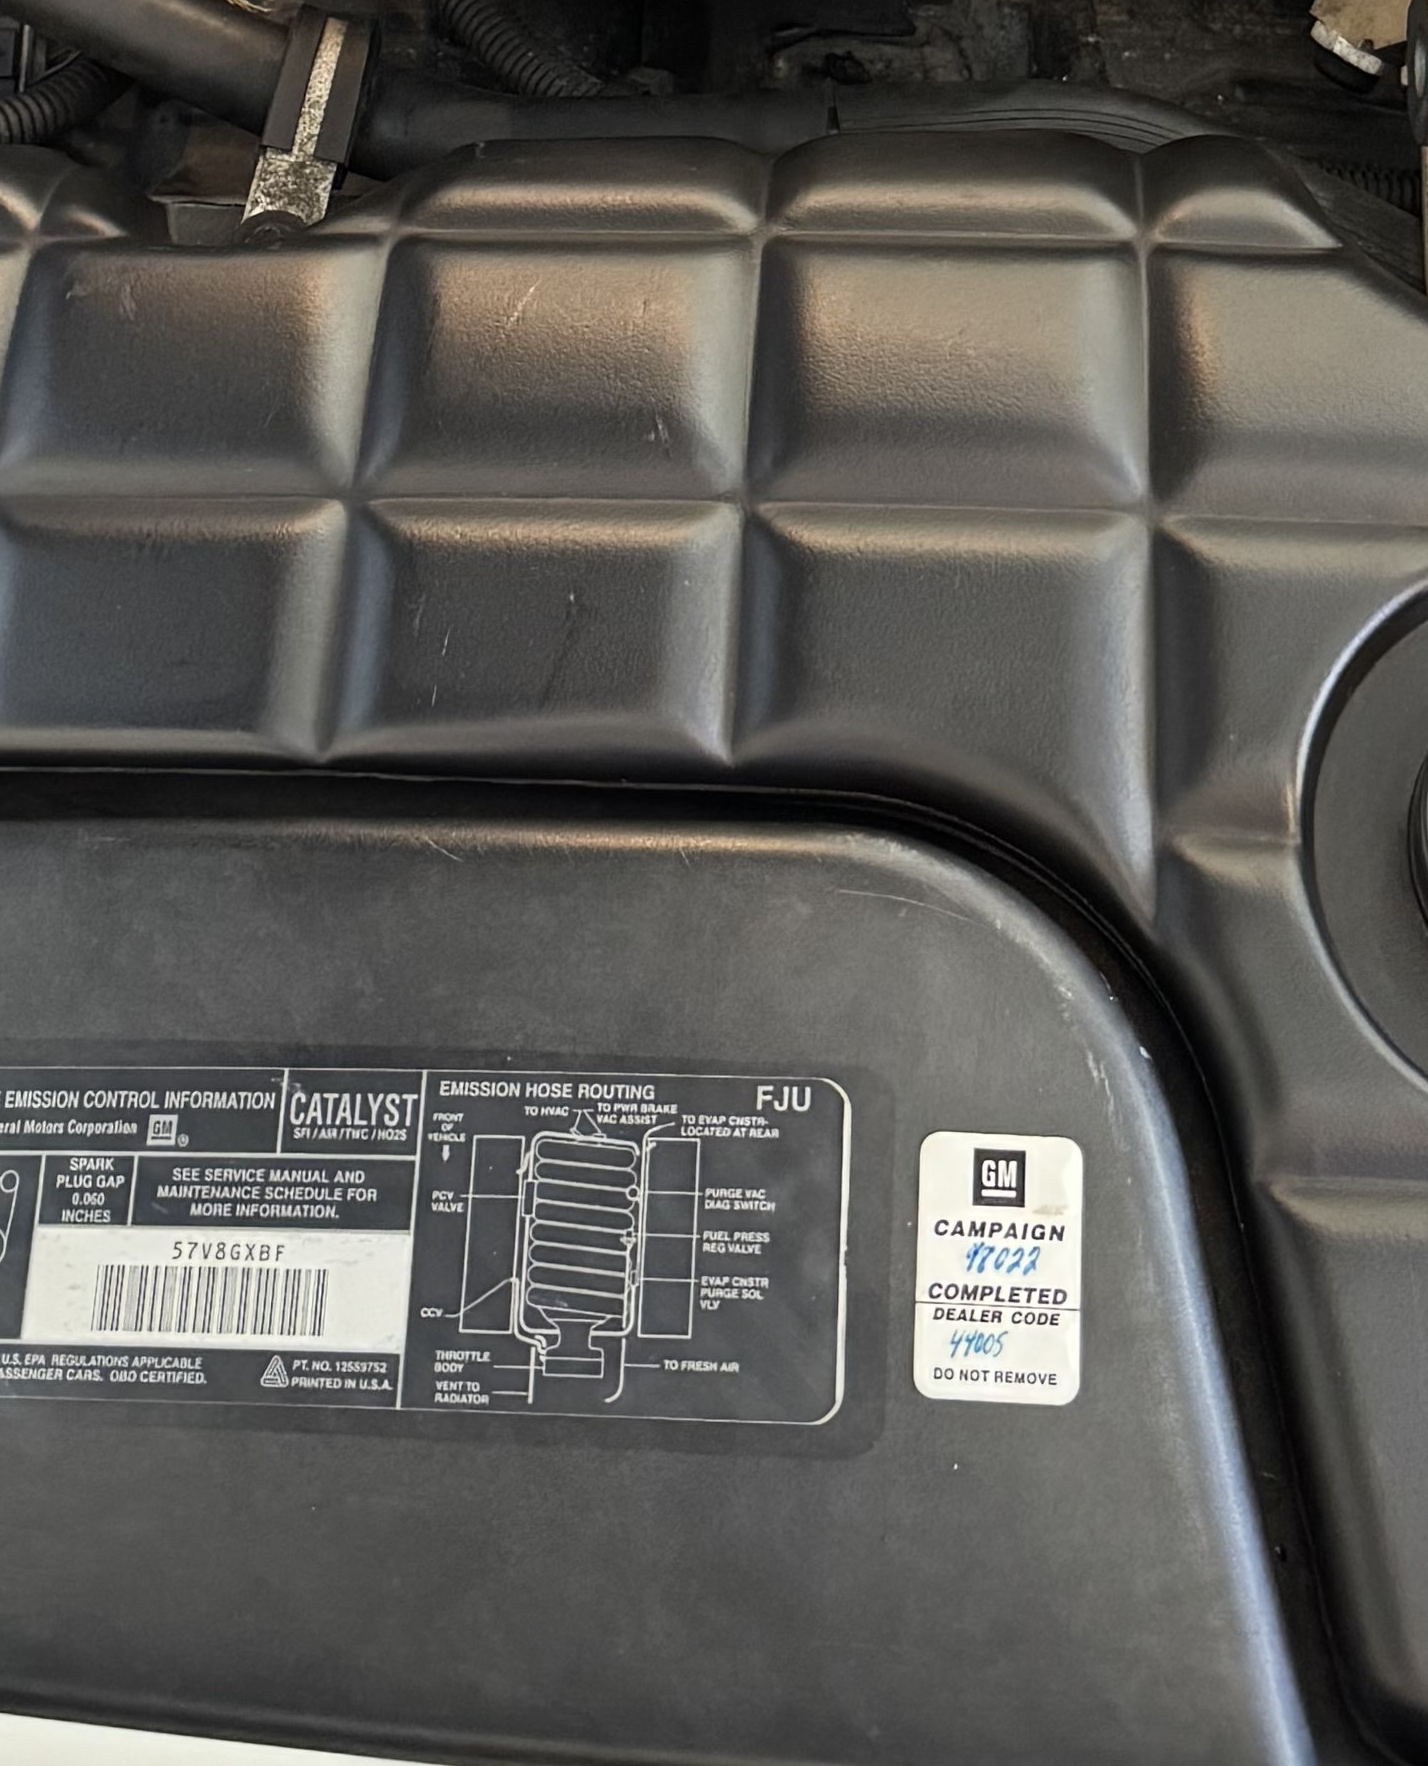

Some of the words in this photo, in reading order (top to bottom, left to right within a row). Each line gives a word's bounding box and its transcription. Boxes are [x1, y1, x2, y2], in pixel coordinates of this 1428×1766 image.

[440, 1081, 520, 1097] EMISSION
[526, 1082, 573, 1098] HOSE
[578, 1084, 655, 1100] ROUTING
[5, 1090, 80, 1108] EMISSION
[83, 1091, 160, 1109] CONTROL
[164, 1091, 275, 1110] INFORMATION
[756, 1085, 811, 1112] FJU
[289, 1092, 418, 1127] CATALYST
[524, 1106, 538, 1116] TO
[541, 1106, 569, 1117] HVAC
[598, 1103, 611, 1113] TO
[614, 1103, 638, 1113] PWR
[640, 1103, 678, 1114] BRAKE
[433, 1113, 464, 1122] FRONT
[597, 1114, 618, 1124] VAC
[619, 1115, 658, 1125] ASSIST
[682, 1115, 696, 1125] TO
[699, 1115, 726, 1125] EVAP
[24, 1120, 64, 1134] Motors
[68, 1120, 137, 1137] Corporation
[441, 1123, 453, 1132] OF
[681, 1126, 731, 1137] LOCATED
[733, 1127, 747, 1137] AT
[749, 1128, 780, 1138] REAR
[428, 1133, 466, 1142] VEHICLE
[70, 1158, 114, 1170] SPARK
[172, 1168, 199, 1181] SEE
[205, 1168, 265, 1182] SERVICE
[269, 1169, 329, 1183] MANUAL
[334, 1170, 365, 1183] AND
[981, 1159, 1018, 1189] GM
[56, 1175, 92, 1188] PLUG
[96, 1175, 125, 1188] GAP
[72, 1192, 105, 1205] 0.060
[157, 1185, 260, 1199] MAINTENANCE
[265, 1187, 342, 1201] SCHEDULE
[347, 1188, 377, 1202] FOR
[432, 1190, 454, 1200] PCV
[705, 1188, 743, 1199] PURGE
[745, 1189, 766, 1199] VAC
[190, 1203, 231, 1217] MORE
[236, 1203, 340, 1218] INFORMATION.
[431, 1202, 464, 1213] VALVE
[704, 1200, 731, 1210] DIAG
[733, 1200, 775, 1212] SWITCH
[62, 1210, 111, 1222] INCHES
[934, 1218, 1066, 1242] CAMPAIGN
[703, 1230, 730, 1241] FUEL
[734, 1231, 770, 1243] PRESS
[703, 1243, 725, 1253] REG
[728, 1244, 762, 1255] VALVE
[701, 1276, 729, 1286] EVAP
[732, 1277, 769, 1289] CNSTR
[700, 1288, 740, 1299] PURGE
[741, 1289, 764, 1300] SOL
[928, 1282, 1068, 1306] COMPLETED
[700, 1300, 720, 1310] VLV
[421, 1307, 444, 1318] CCV
[932, 1307, 1003, 1324] DEALER
[1010, 1310, 1060, 1326] CODE
[1, 1352, 21, 1365] U.S.
[24, 1353, 45, 1365] EPA
[51, 1354, 129, 1367] REGULATIONS
[132, 1355, 203, 1369] APPLICABLE
[435, 1350, 491, 1363] THROTTLE
[312, 1360, 332, 1372] NO.
[433, 1362, 464, 1373] BODY
[663, 1359, 679, 1371] TO
[680, 1360, 718, 1372] FRESH
[720, 1361, 740, 1373] AIR
[66, 1368, 104, 1382] CARS.
[140, 1371, 207, 1384] CERTIFIED.
[933, 1366, 954, 1381] DO
[958, 1368, 989, 1382] NOT
[994, 1370, 1058, 1386] REMOVE
[291, 1377, 342, 1389] PRINTED
[344, 1378, 357, 1389] IN
[435, 1381, 464, 1392] VENT
[466, 1381, 480, 1392] TO
[434, 1393, 490, 1405] RADIATOR
